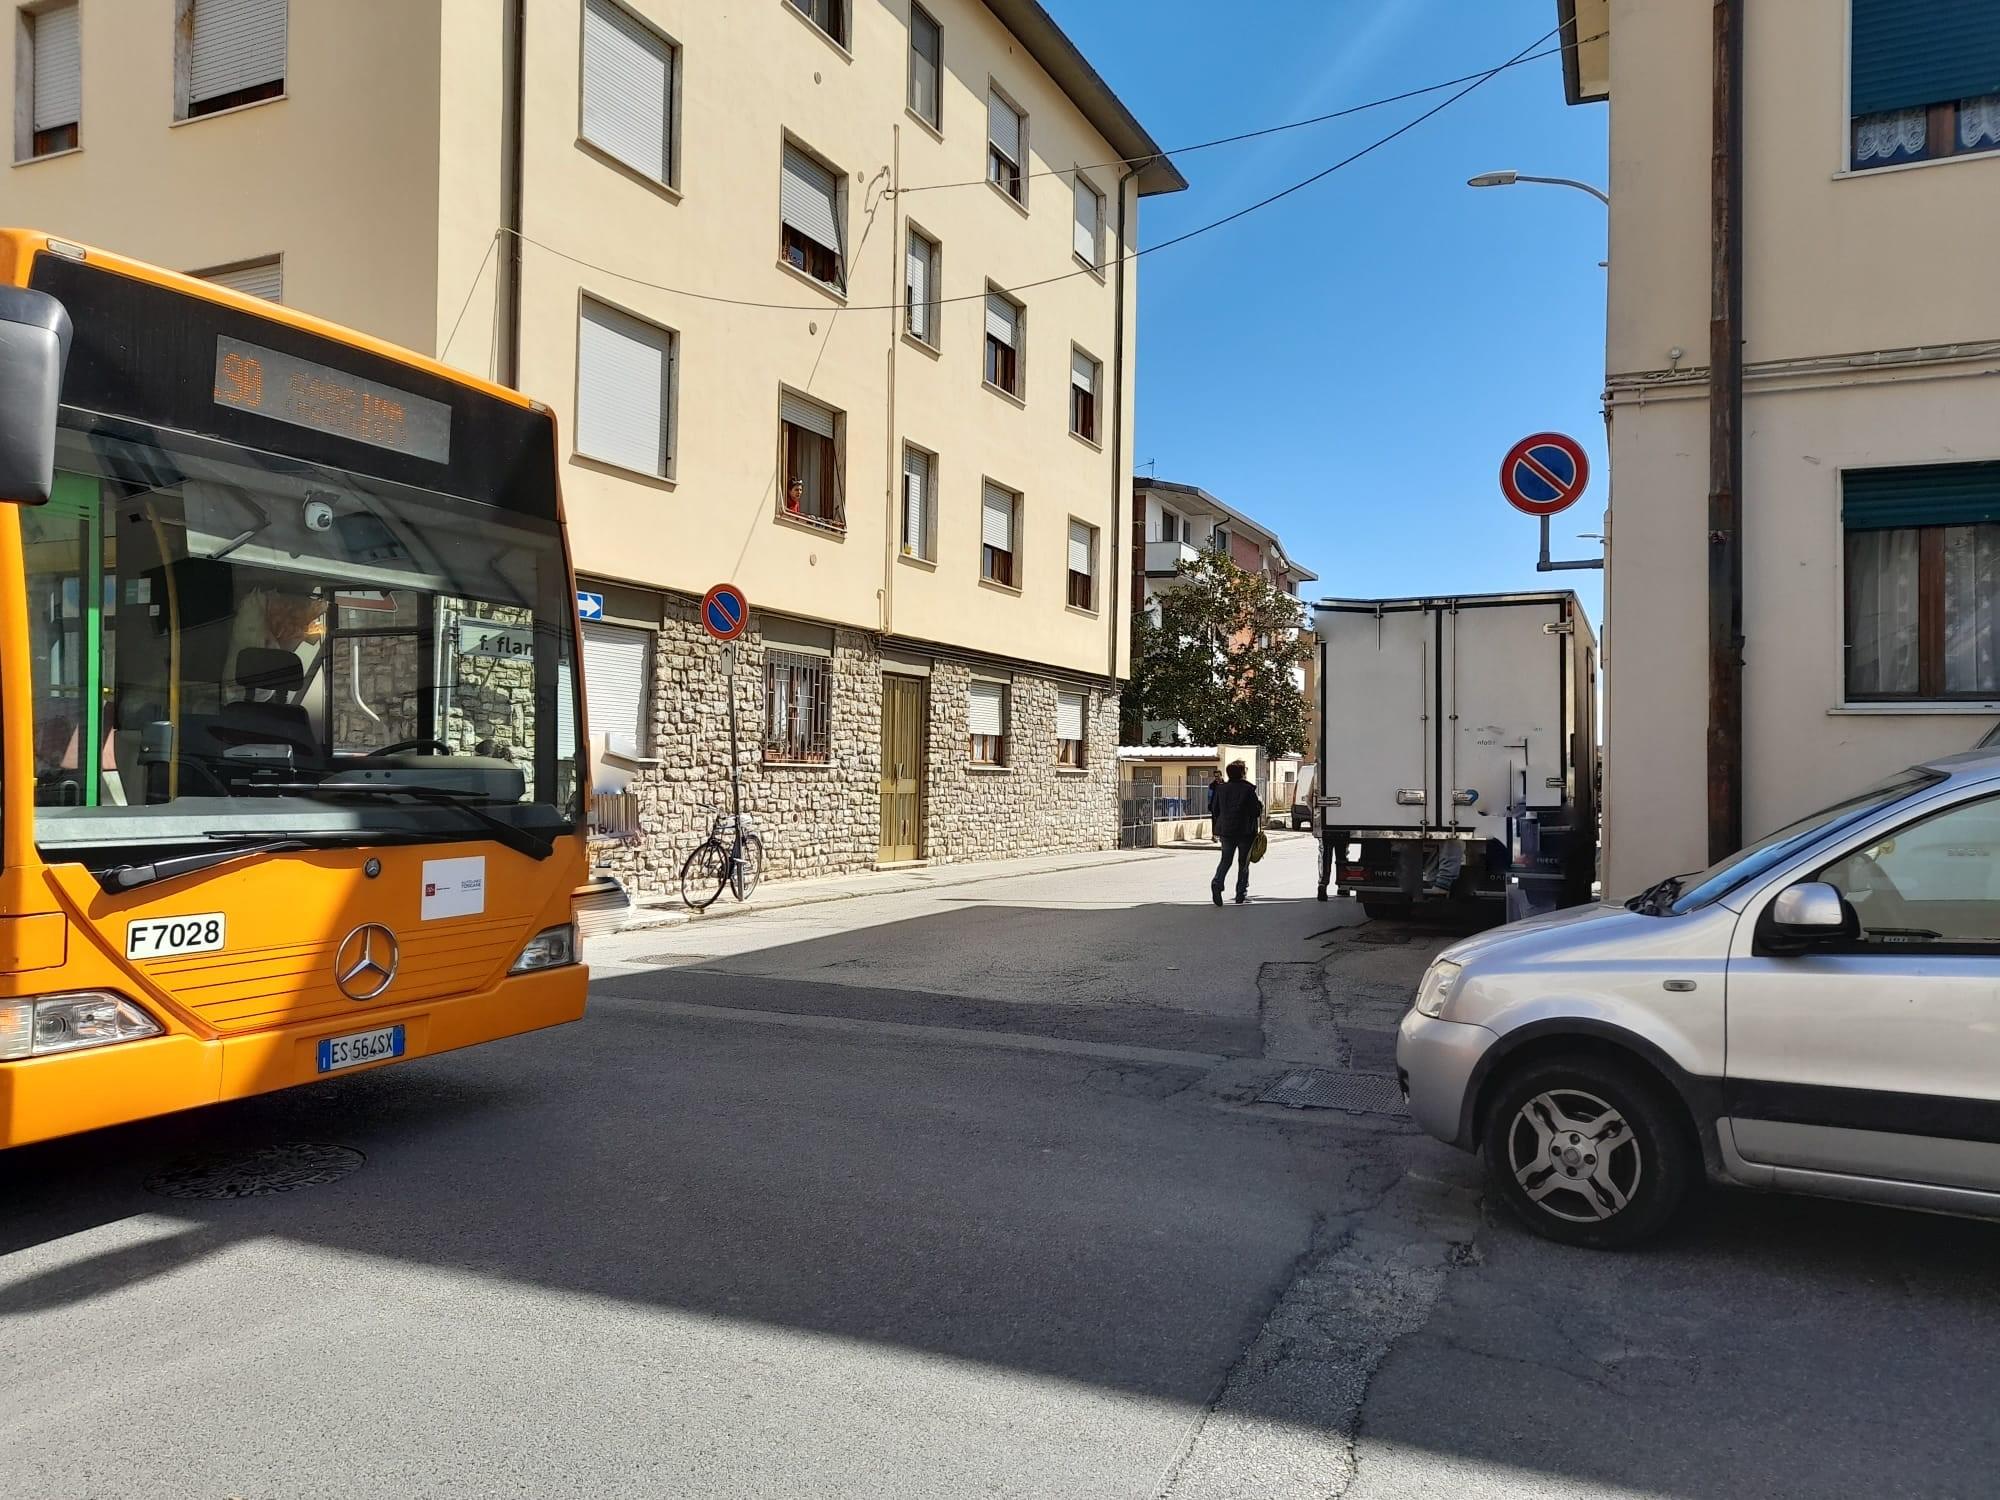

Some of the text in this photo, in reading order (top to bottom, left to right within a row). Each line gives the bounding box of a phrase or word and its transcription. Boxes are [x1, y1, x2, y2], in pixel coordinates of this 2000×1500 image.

[130, 920, 220, 953] F7028
[331, 1042, 348, 1064] ES
[352, 1032, 394, 1060] 564SX
